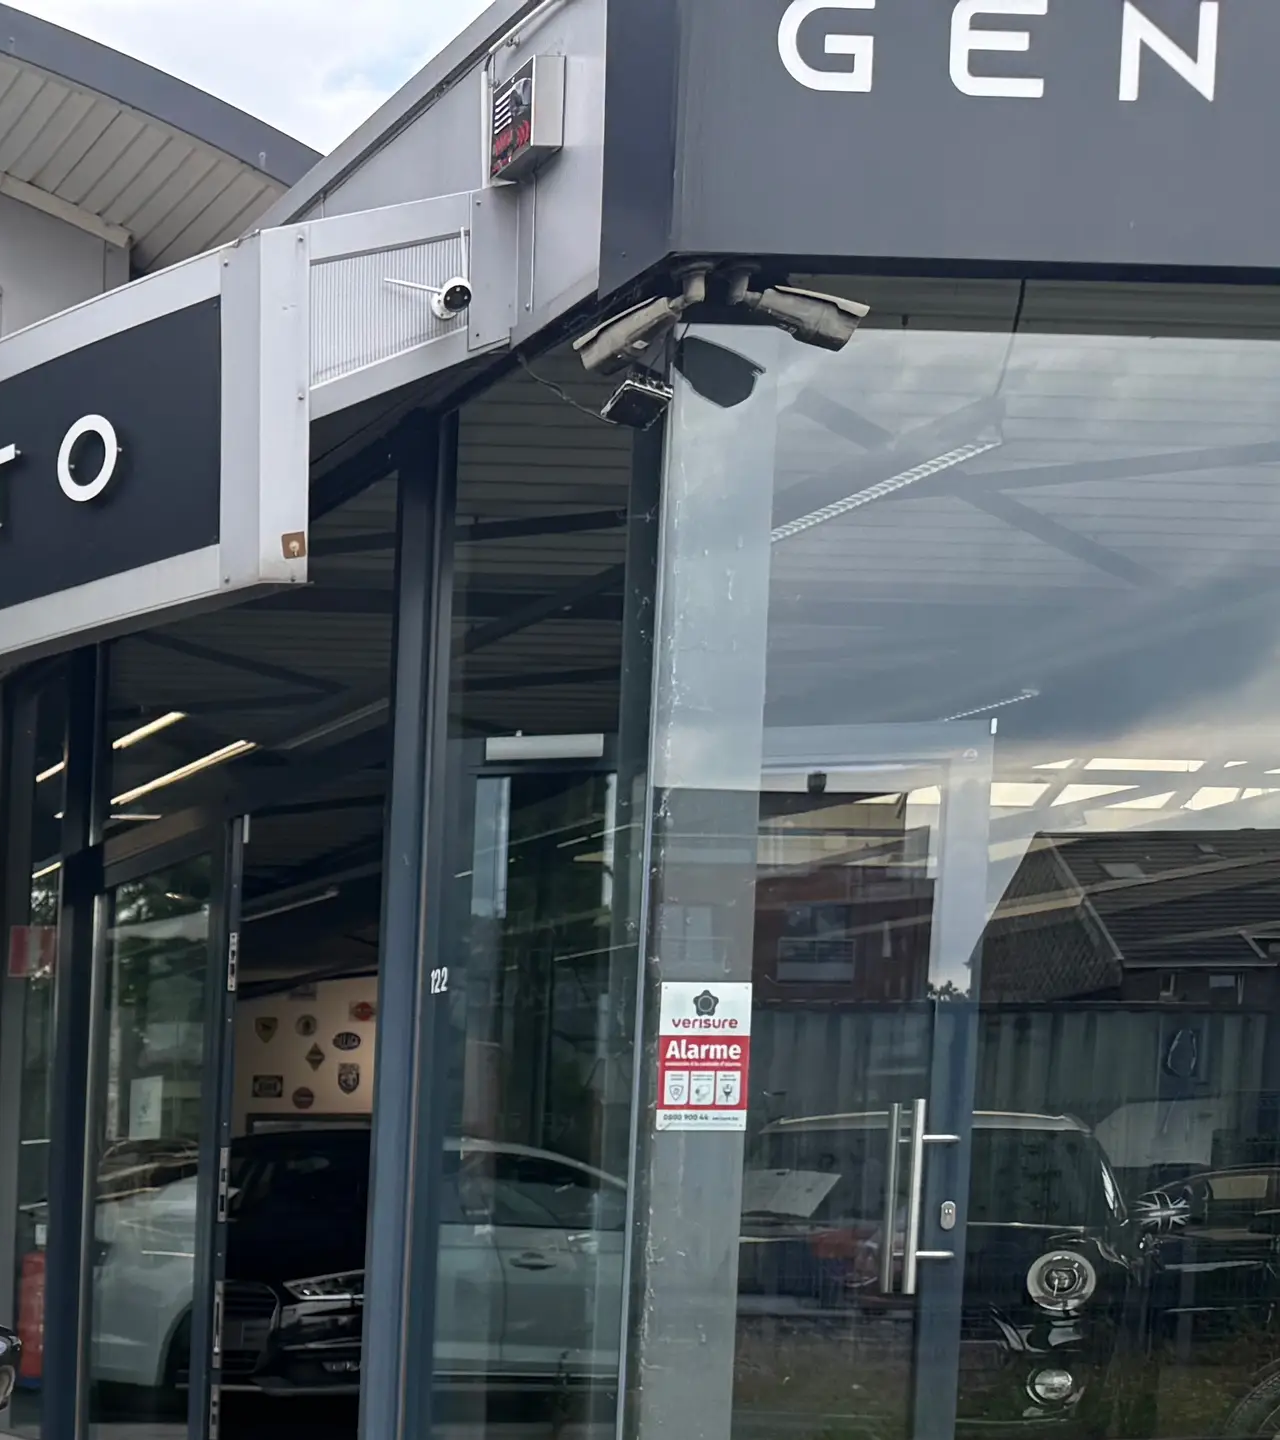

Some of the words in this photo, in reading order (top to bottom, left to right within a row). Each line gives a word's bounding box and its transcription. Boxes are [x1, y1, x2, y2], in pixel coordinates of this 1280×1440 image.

[777, 0, 1220, 102] GEN
[430, 966, 449, 994] 122
[672, 1017, 738, 1029] verisure
[666, 1039, 742, 1060] Alarme
